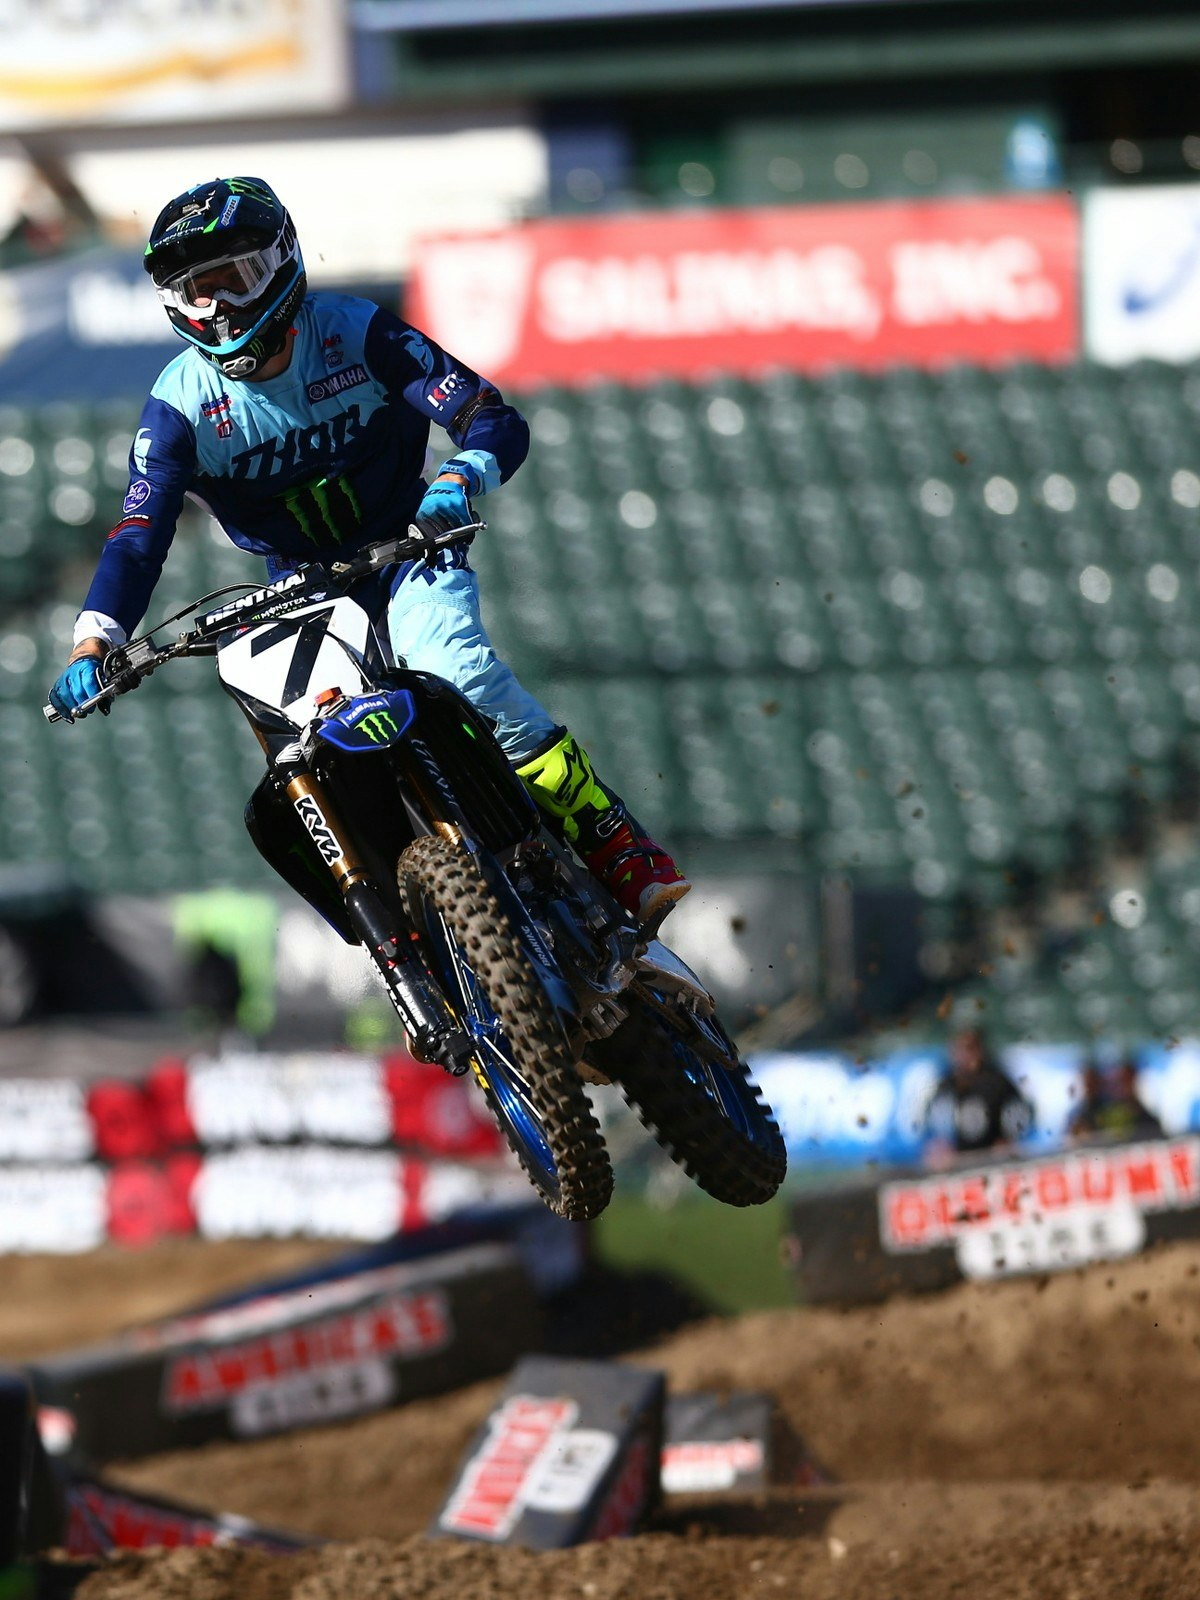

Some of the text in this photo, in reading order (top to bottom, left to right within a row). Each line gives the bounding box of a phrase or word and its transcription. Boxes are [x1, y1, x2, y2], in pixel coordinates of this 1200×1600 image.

[322, 367, 367, 396] YAMAHA
[251, 605, 336, 709] 7
[346, 700, 384, 722] YAMAHA
[294, 795, 344, 866] KYB
[521, 925, 552, 967] BRAKING
